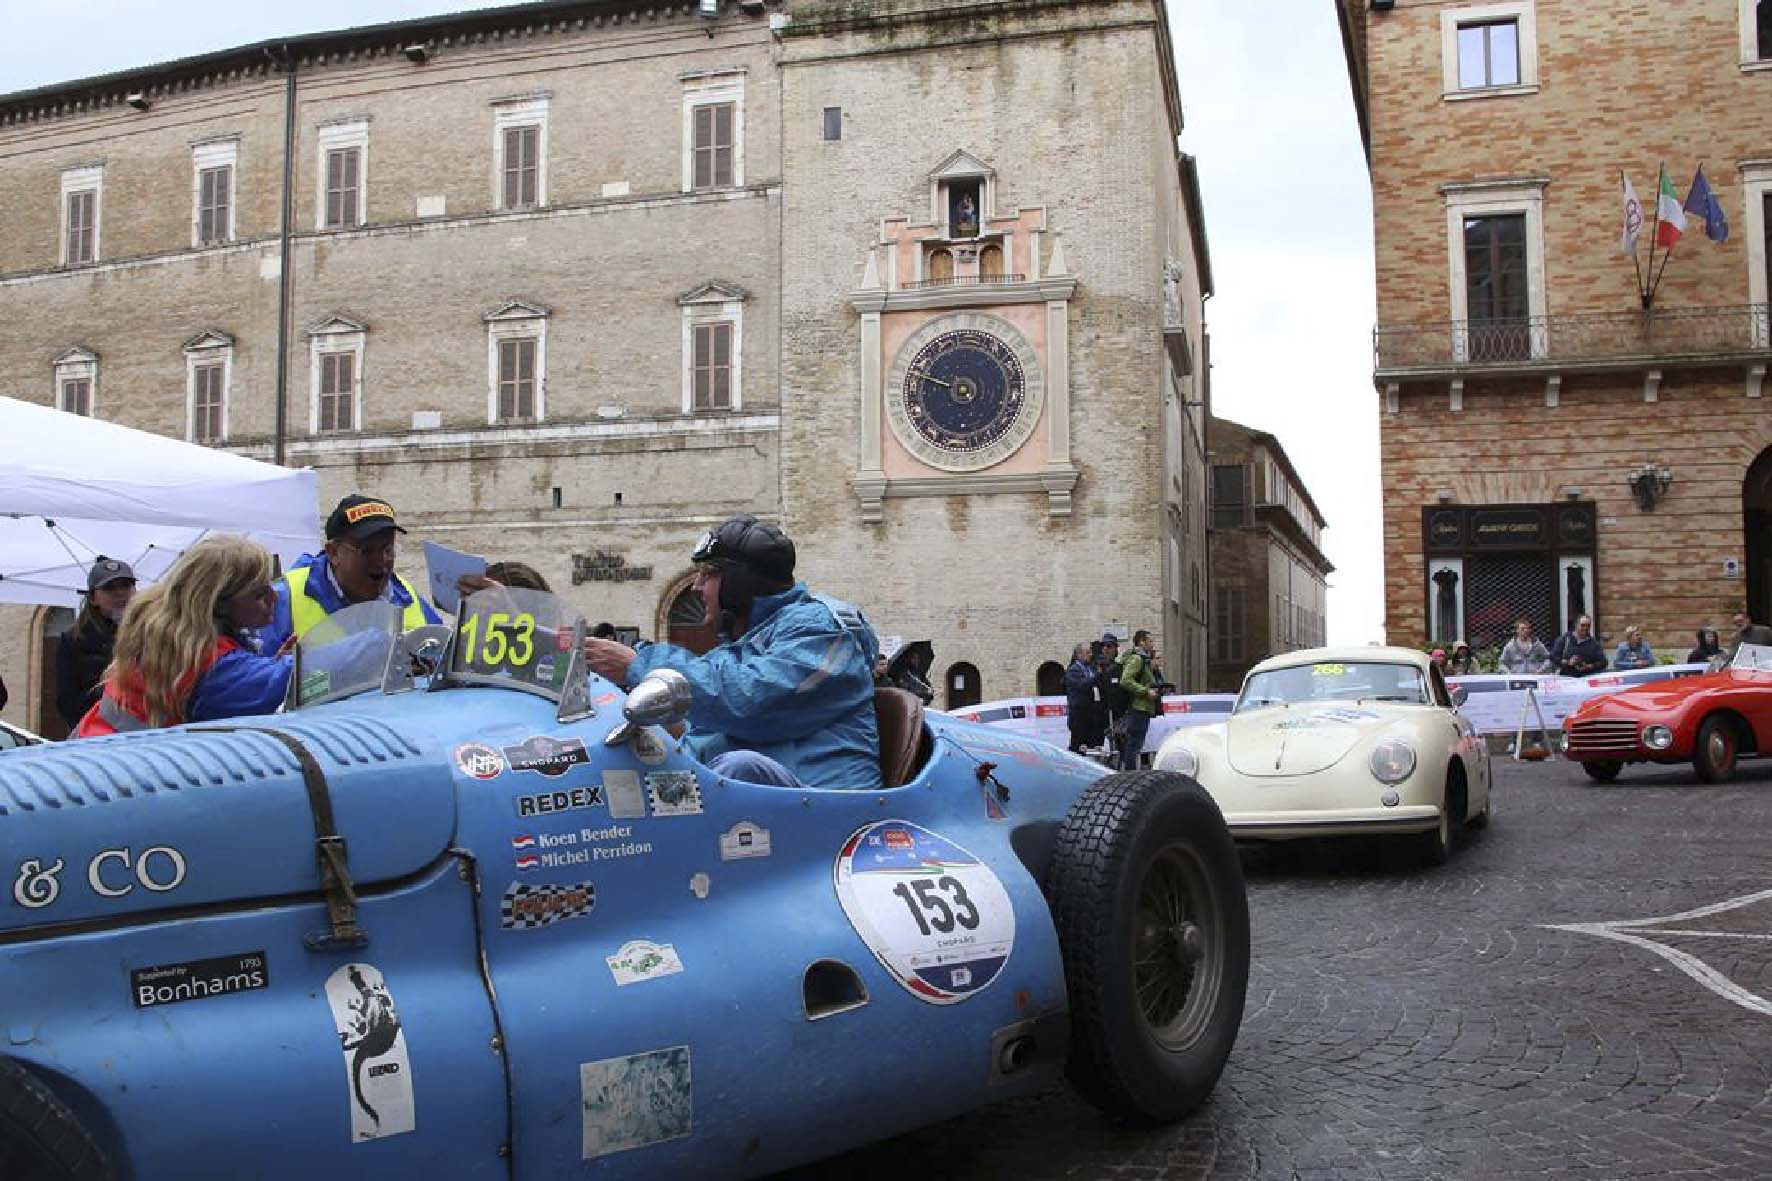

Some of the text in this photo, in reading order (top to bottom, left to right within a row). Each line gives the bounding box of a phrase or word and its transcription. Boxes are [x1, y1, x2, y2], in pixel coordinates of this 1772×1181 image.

[460, 612, 535, 666] 153
[520, 787, 602, 816] REDEX
[539, 825, 632, 848] Koen Bender
[541, 841, 653, 867] Michel Perridon
[14, 845, 187, 908] & CO
[893, 876, 980, 936] 153
[140, 971, 264, 1006] Bonhams
